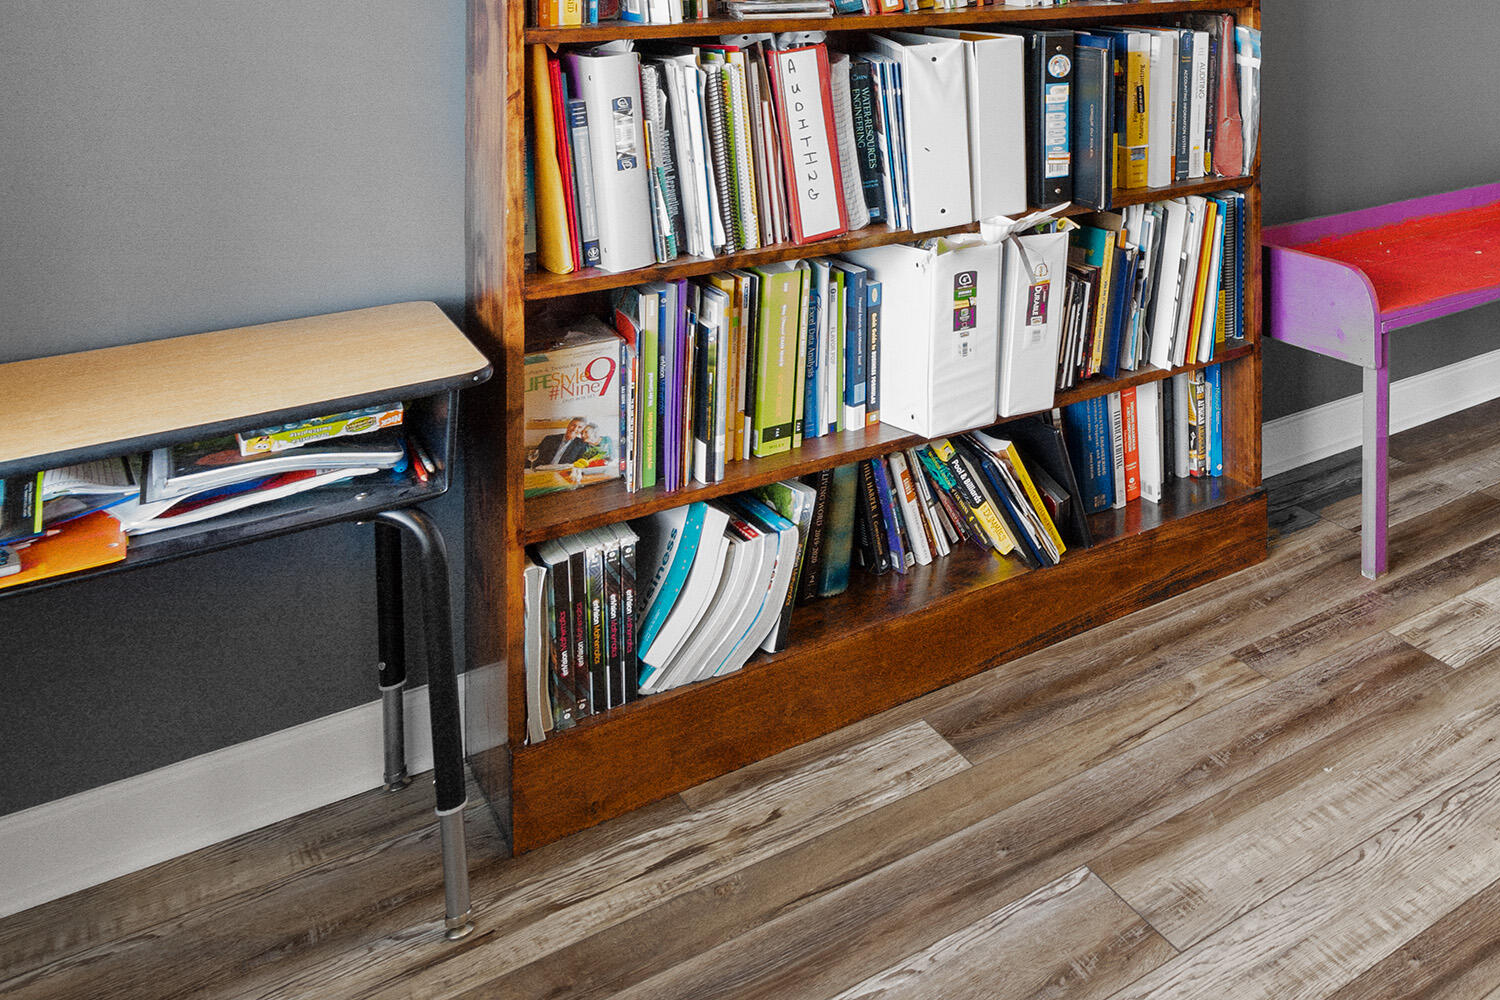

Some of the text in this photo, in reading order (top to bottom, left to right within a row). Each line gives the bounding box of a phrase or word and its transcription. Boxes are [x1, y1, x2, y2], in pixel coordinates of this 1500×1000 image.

[1198, 62, 1206, 99] AUDITING
[787, 58, 820, 201] AUDITING
[852, 88, 865, 148] ENGINEERING
[861, 87, 877, 169] WATER-RESOURCES
[808, 306, 816, 325] Excel
[1032, 286, 1042, 316] DURABLE
[584, 356, 617, 397] 9
[807, 347, 815, 378] Analysis
[549, 381, 601, 400] #Nine
[380, 413, 403, 426] NICK
[864, 463, 877, 511] HILL HARPER
[951, 459, 962, 474] Pool
[967, 479, 982, 504] Billiards
[811, 473, 830, 564] LIVING WORD 2019-2020
[638, 527, 678, 613] usiness
[559, 611, 567, 651] Mathematics
[592, 599, 601, 664] enVision Mathematics
